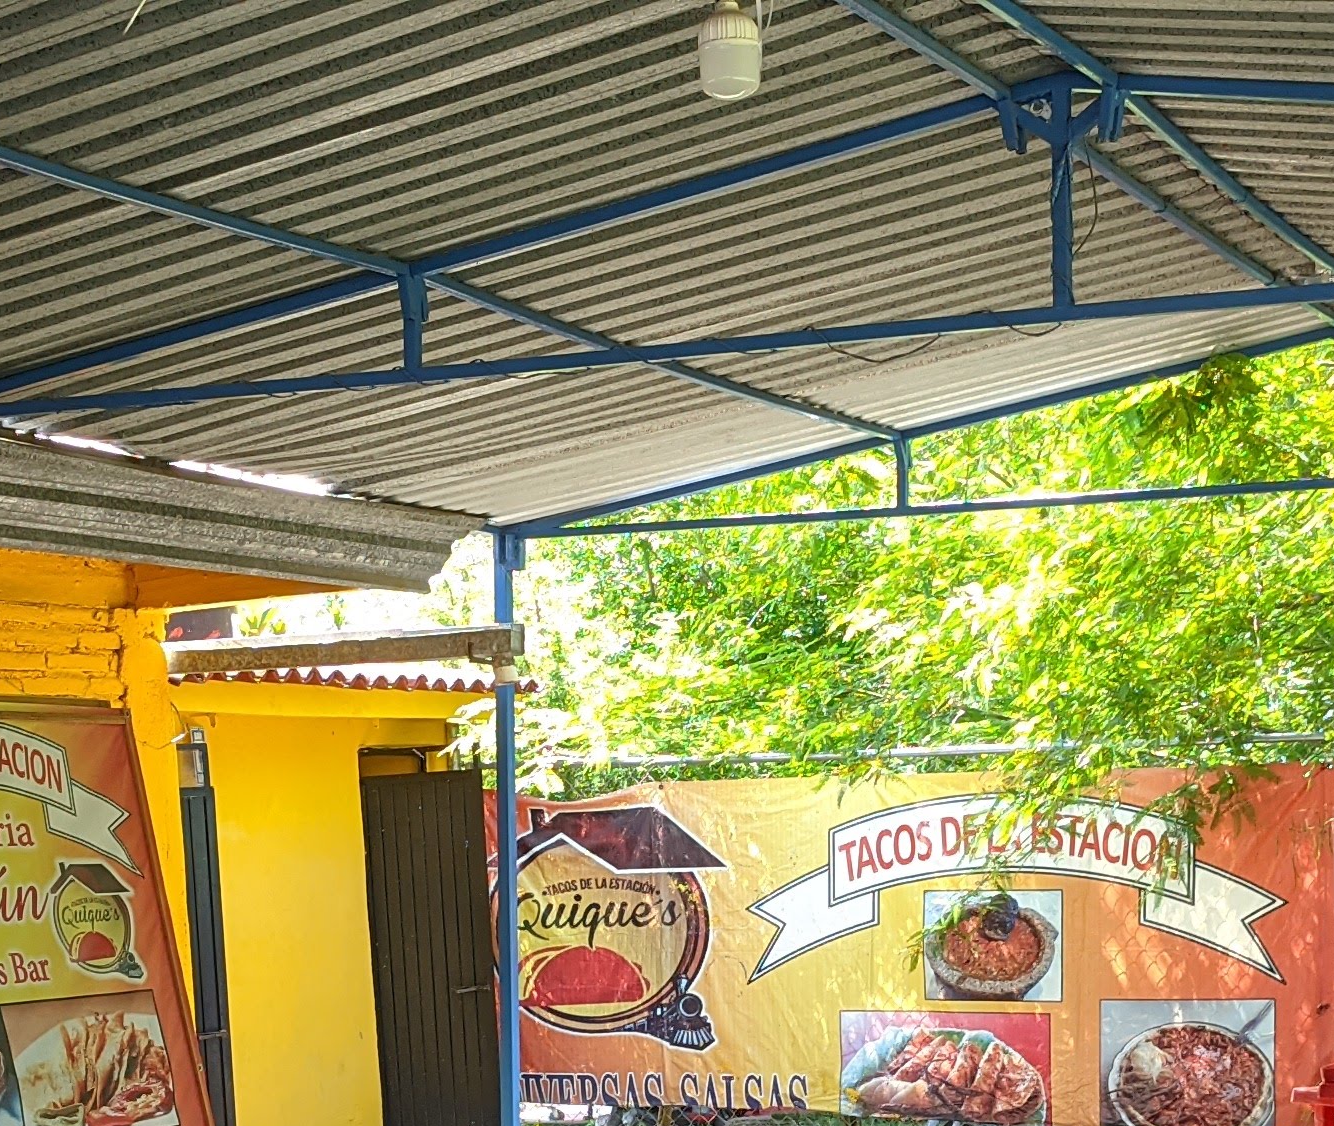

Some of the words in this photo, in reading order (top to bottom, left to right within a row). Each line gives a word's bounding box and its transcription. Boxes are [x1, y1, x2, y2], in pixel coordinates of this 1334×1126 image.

[838, 820, 933, 882] TACOS
[546, 879, 578, 897] TACOS
[580, 877, 593, 891] DE
[594, 876, 608, 890] LA
[8, 952, 51, 984] Bar
